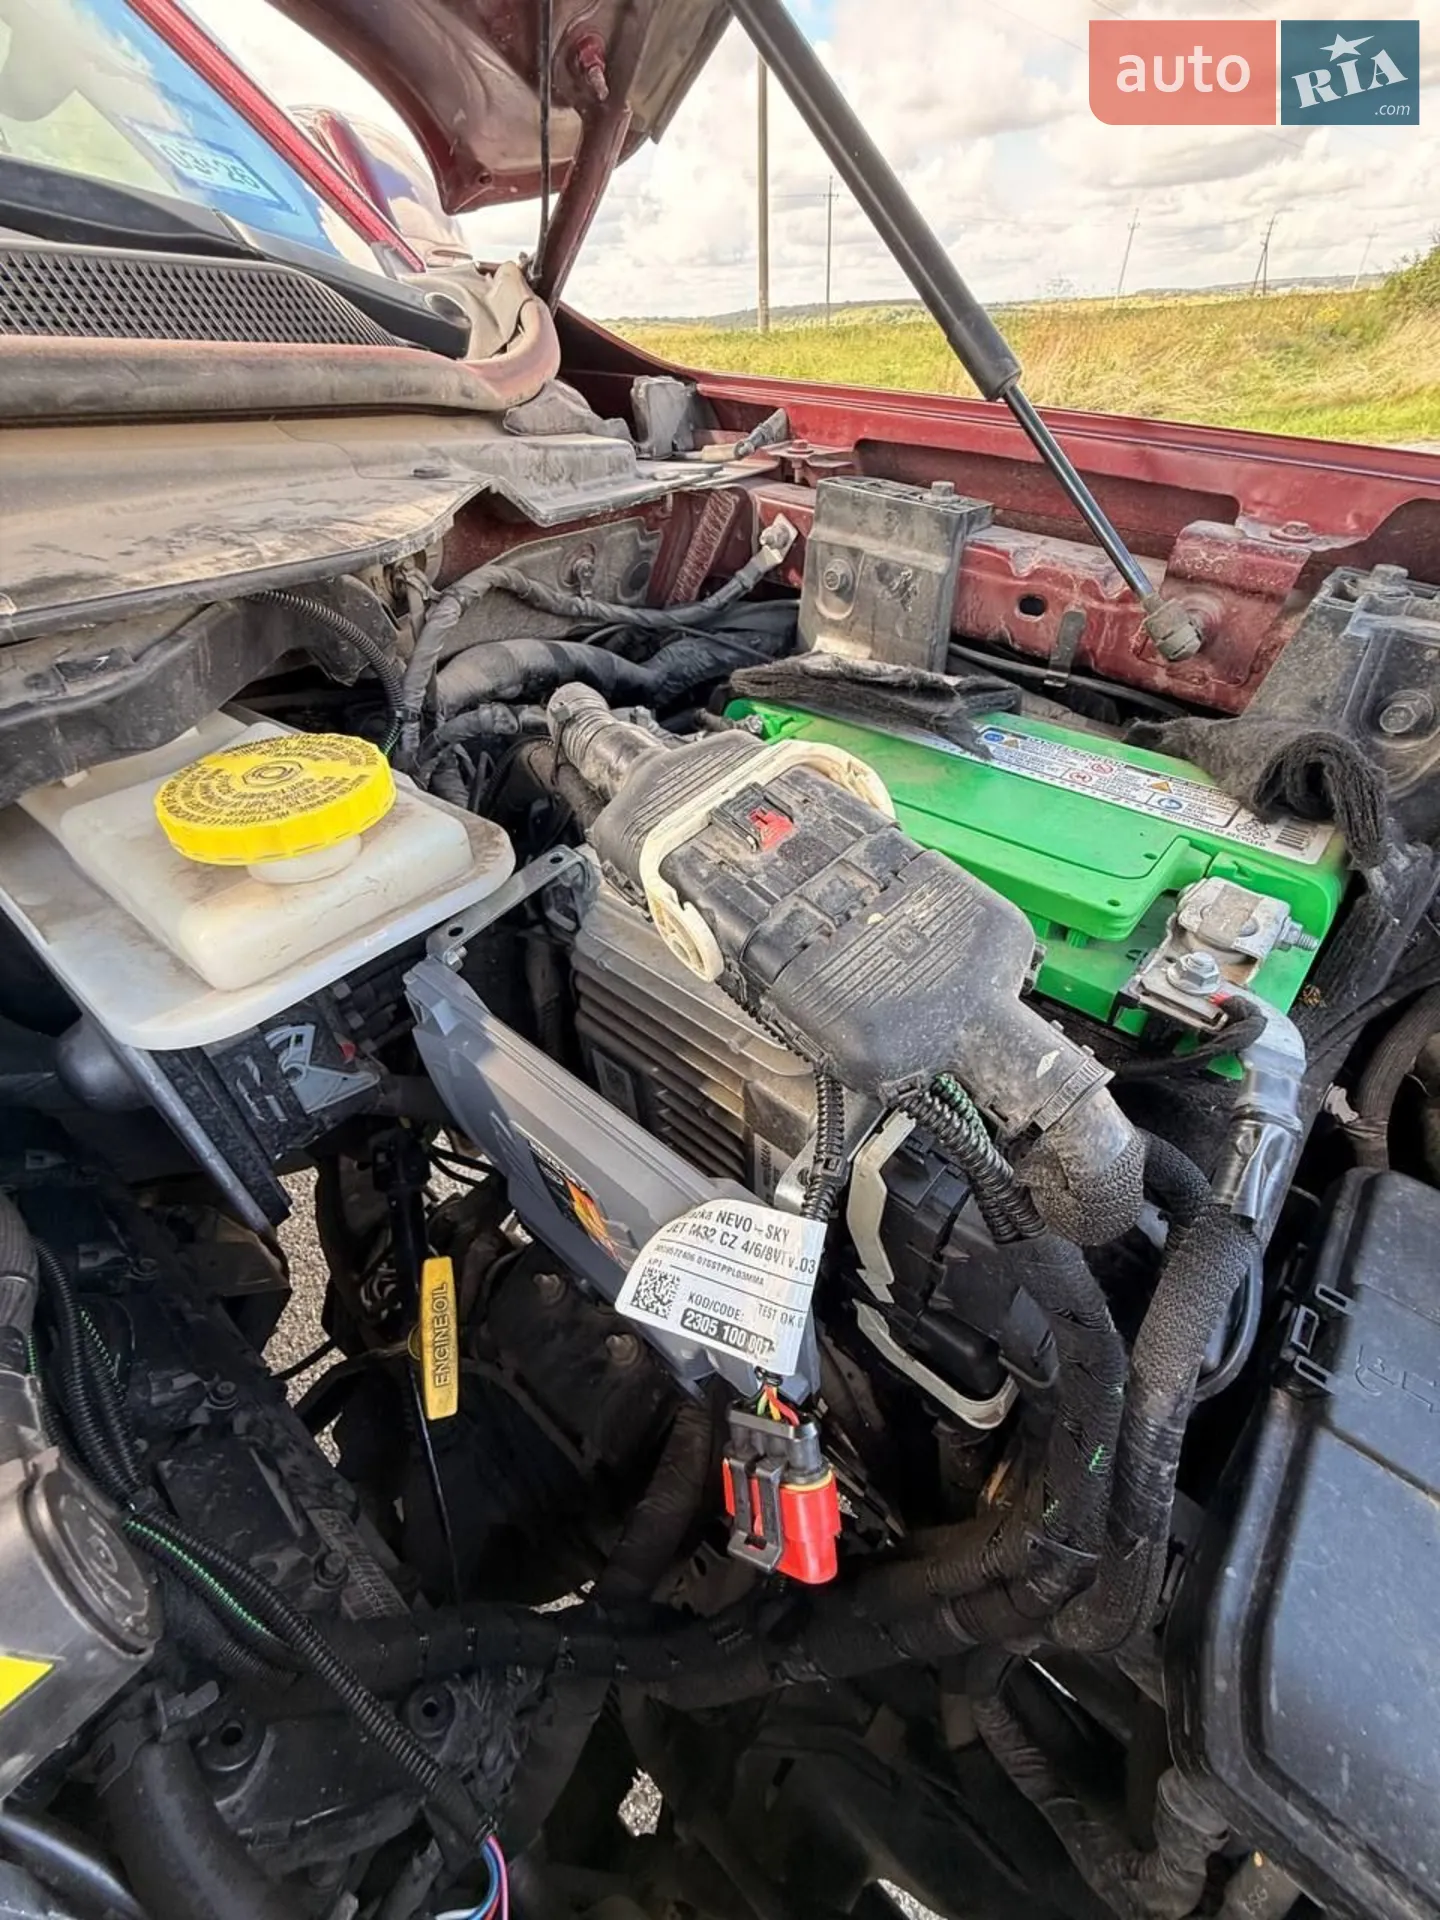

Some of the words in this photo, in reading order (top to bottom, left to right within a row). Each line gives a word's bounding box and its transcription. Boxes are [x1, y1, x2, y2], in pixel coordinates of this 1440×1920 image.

[716, 1210, 752, 1233] NEVO
[765, 1225, 790, 1244] SKY
[719, 1231, 740, 1249] CZ
[432, 1281, 448, 1312] OIL
[758, 1303, 777, 1319] TEST
[685, 1310, 717, 1334] 2305
[722, 1325, 748, 1349] 100
[433, 1313, 451, 1388] ENGINE
